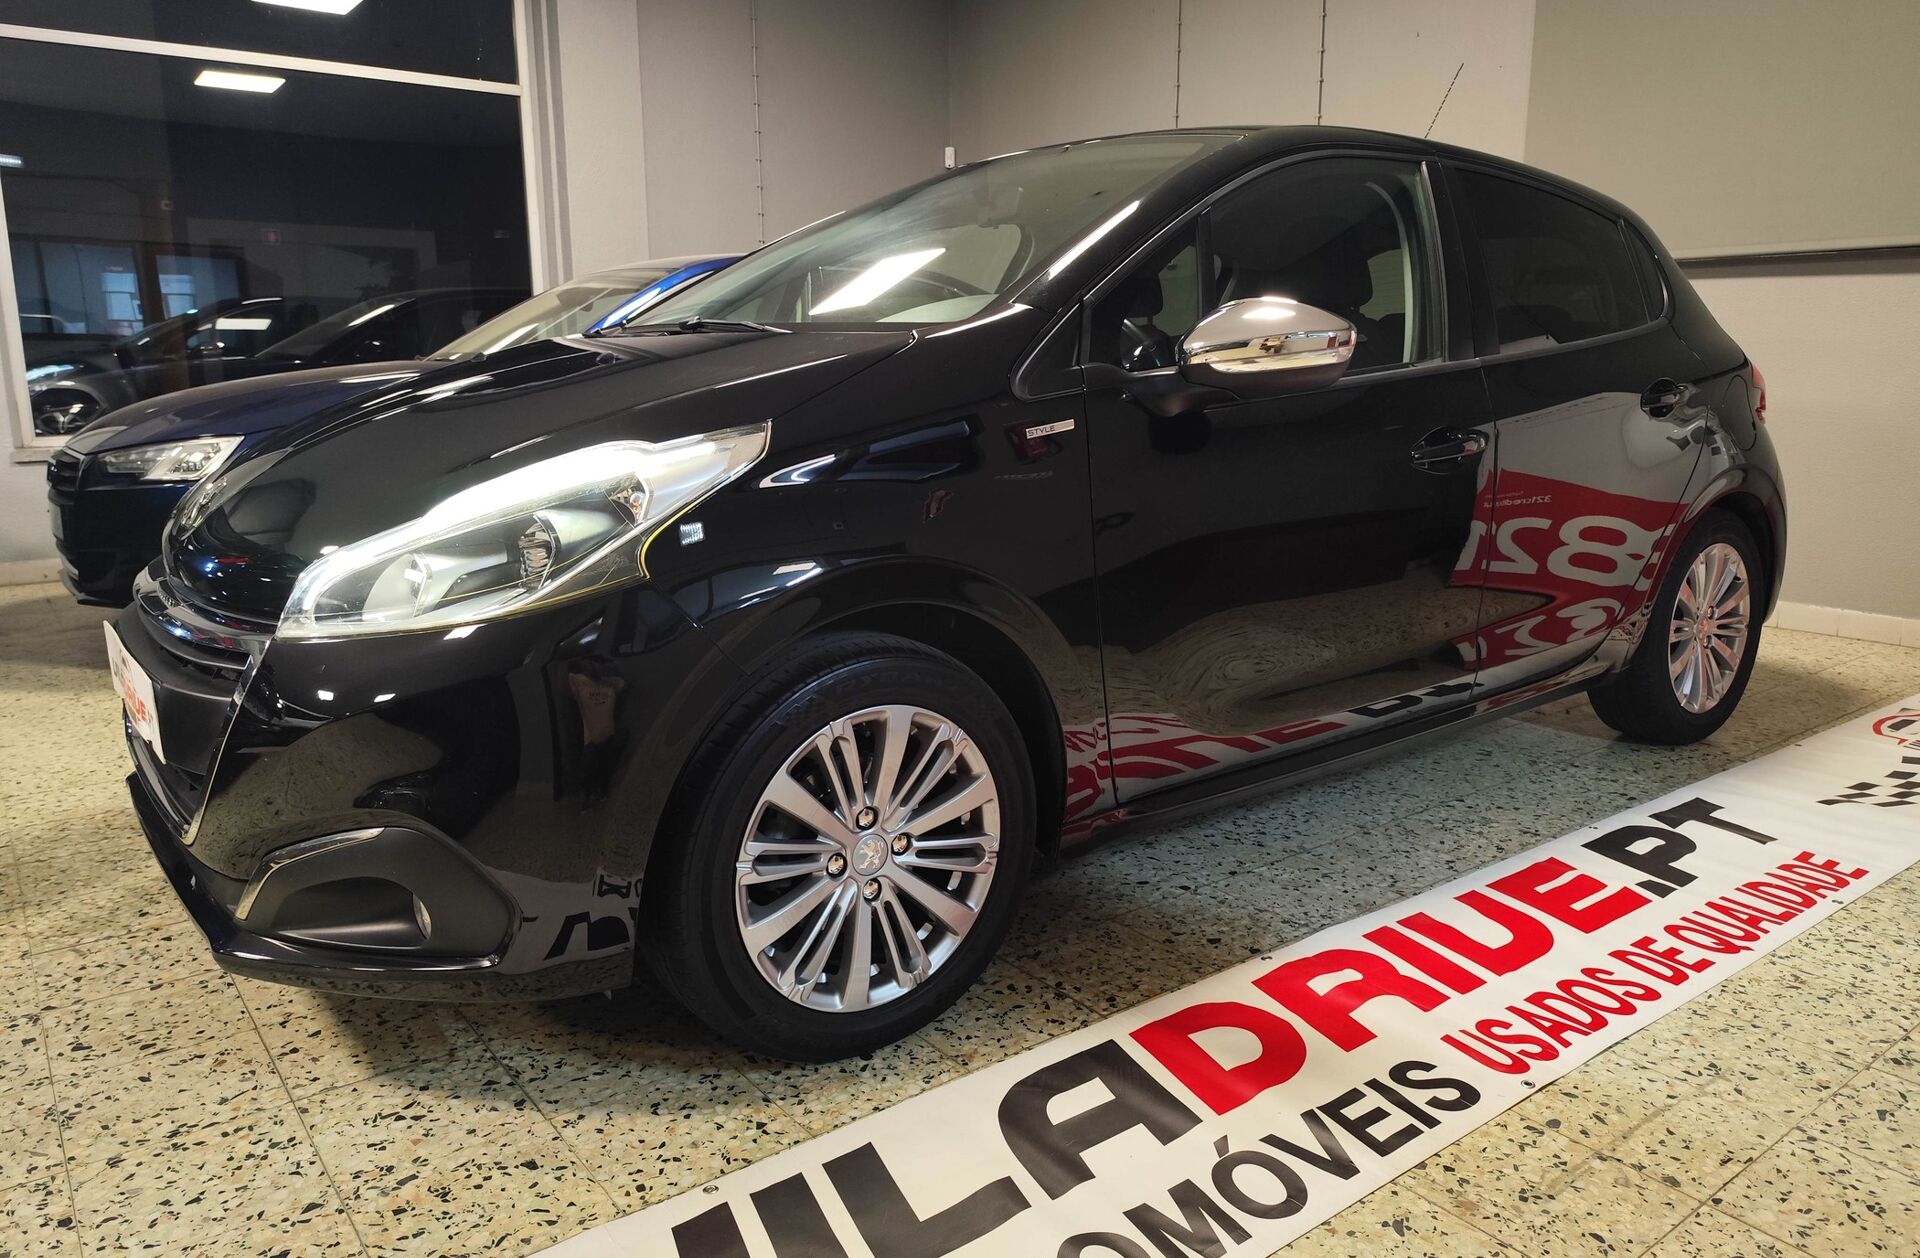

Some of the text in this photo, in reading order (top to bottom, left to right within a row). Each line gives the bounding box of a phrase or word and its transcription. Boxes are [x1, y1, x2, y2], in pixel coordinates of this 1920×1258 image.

[1027, 425, 1056, 437] STYLE
[1440, 967, 1662, 1075] USADOS
[1608, 935, 1716, 986] DE
[1663, 850, 1870, 954] QUALIDADE
